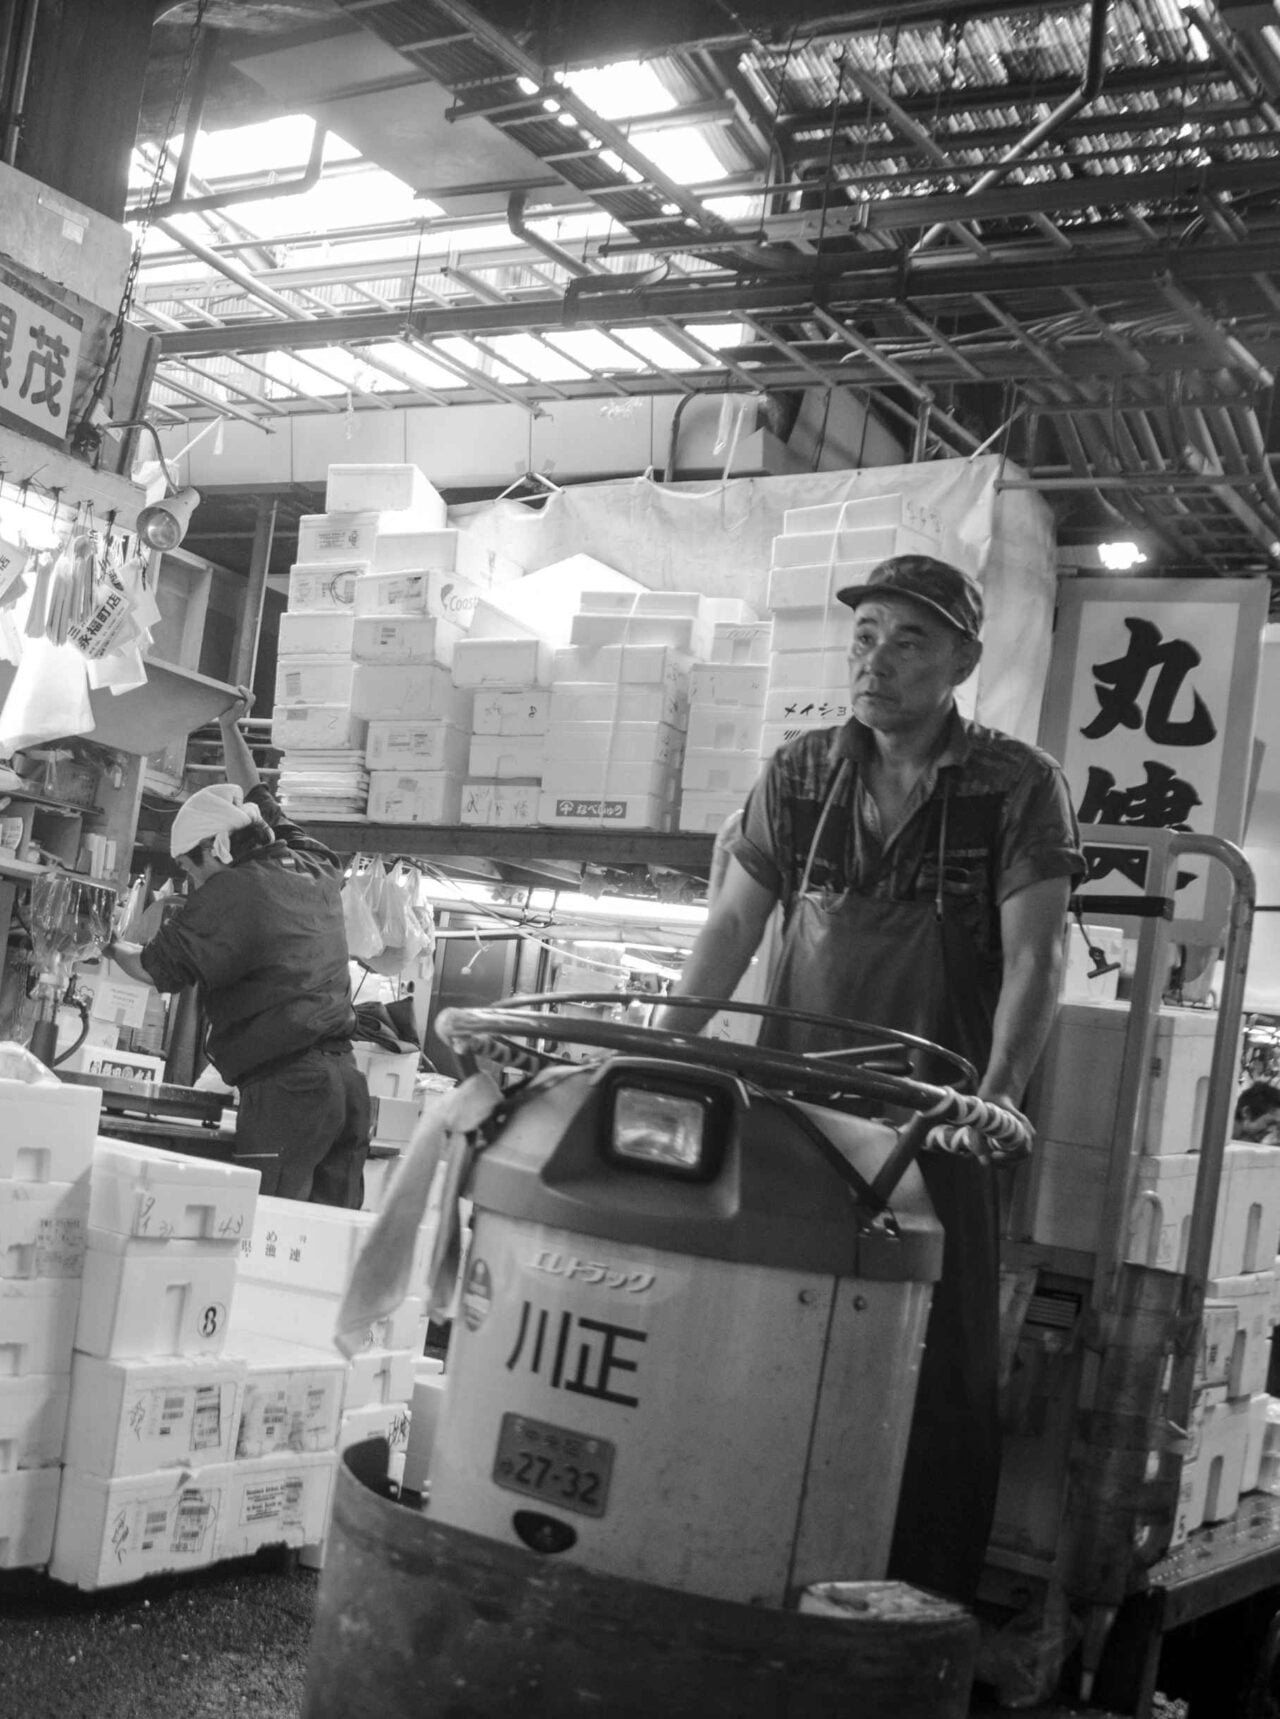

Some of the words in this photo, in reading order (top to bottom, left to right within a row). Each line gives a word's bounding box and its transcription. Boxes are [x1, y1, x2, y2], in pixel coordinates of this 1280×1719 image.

[78, 593, 123, 651] 永福町店
[506, 1300, 648, 1408] 川正
